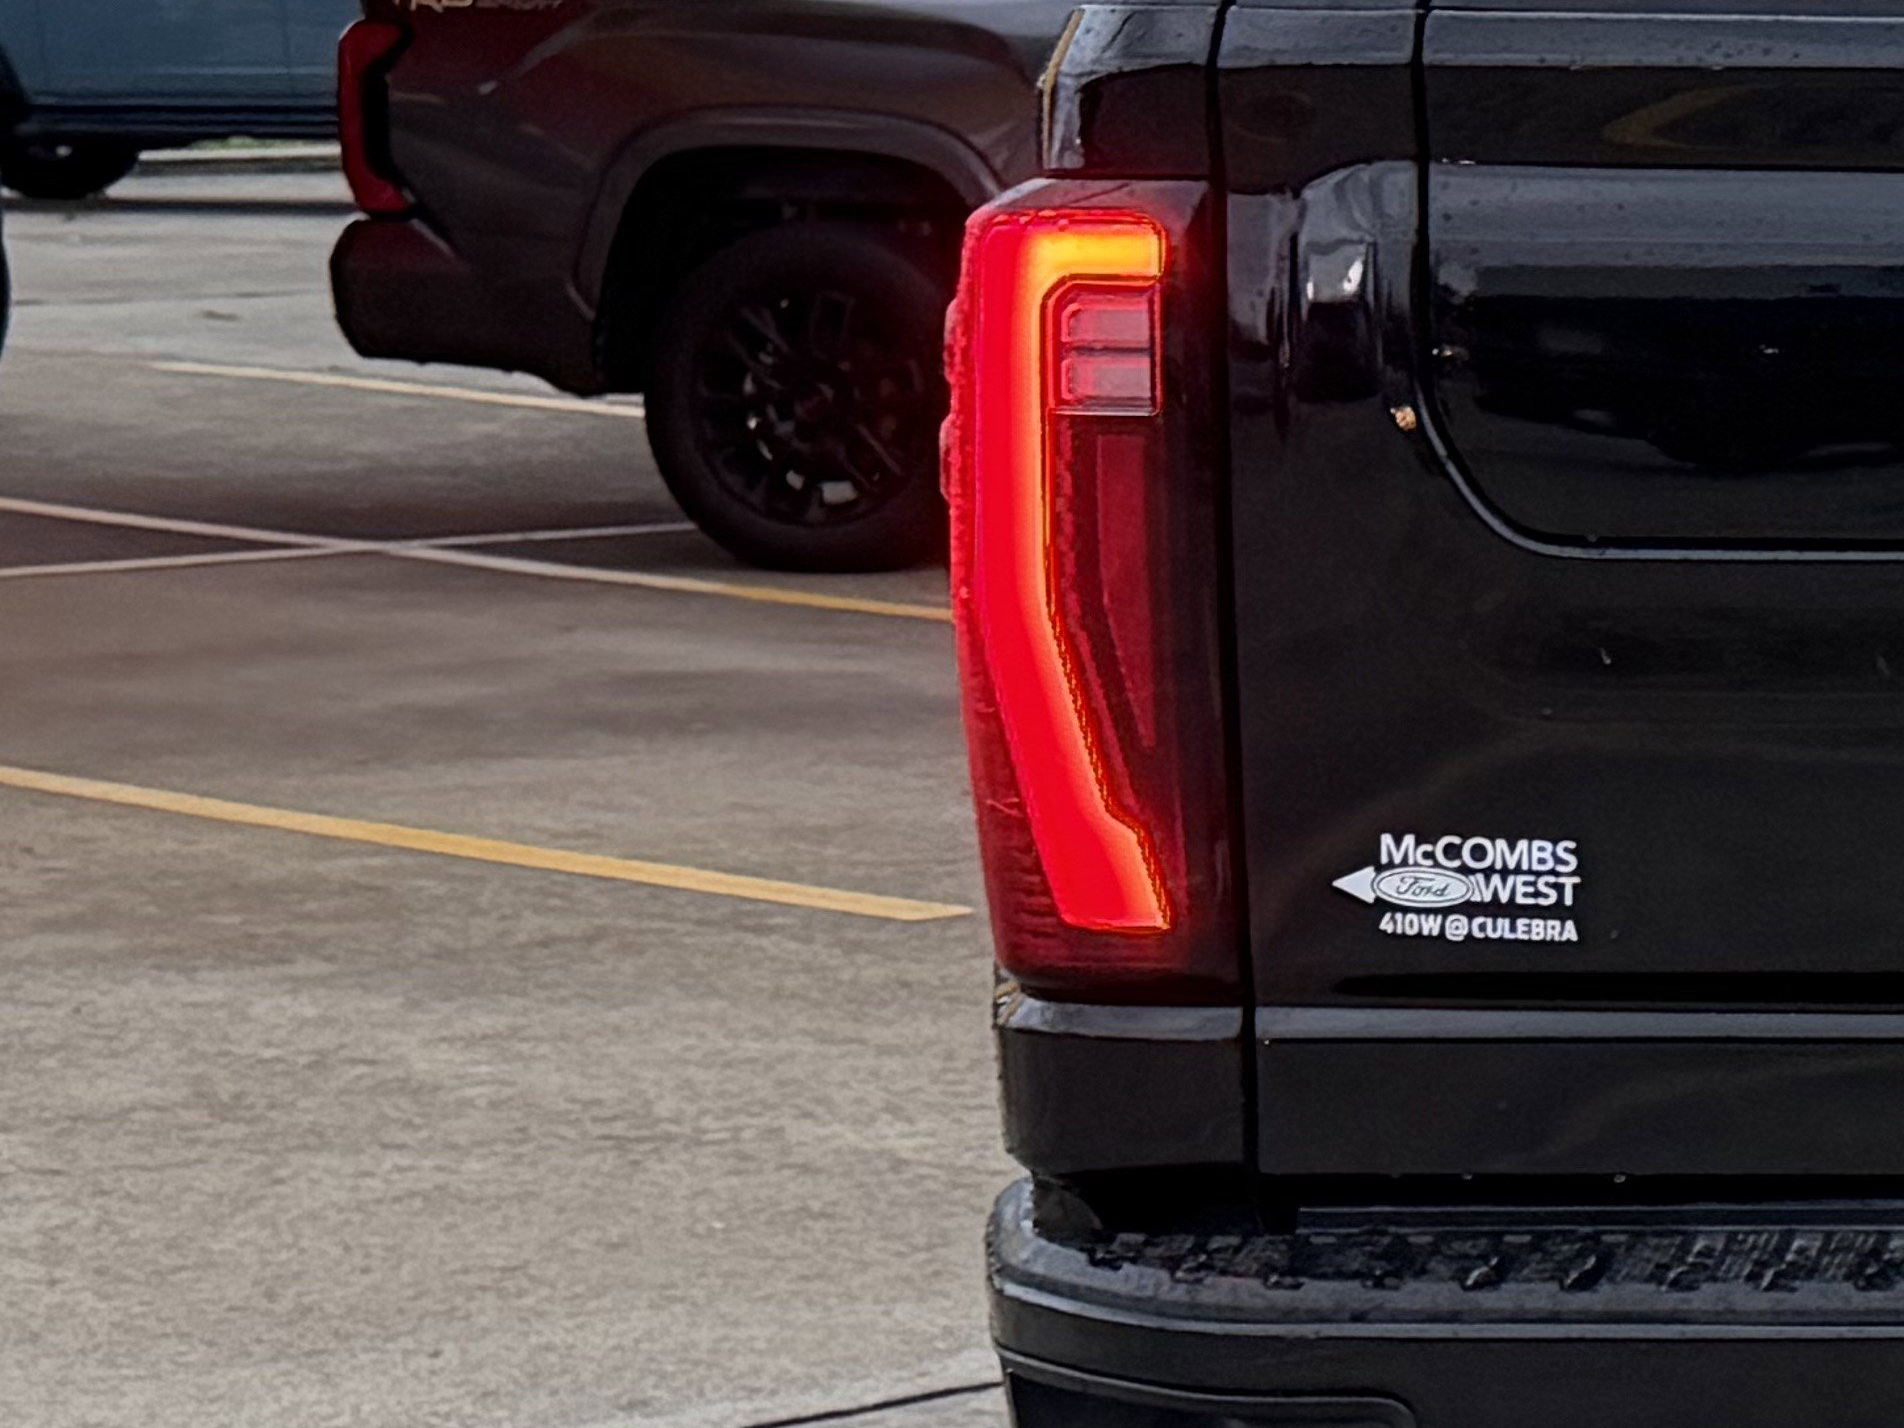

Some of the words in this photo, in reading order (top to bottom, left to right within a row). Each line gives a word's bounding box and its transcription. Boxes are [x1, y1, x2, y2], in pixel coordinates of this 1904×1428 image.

[1380, 833, 1578, 872] McCOMBS
[1396, 876, 1452, 897] Ford
[1476, 872, 1581, 907] WEST
